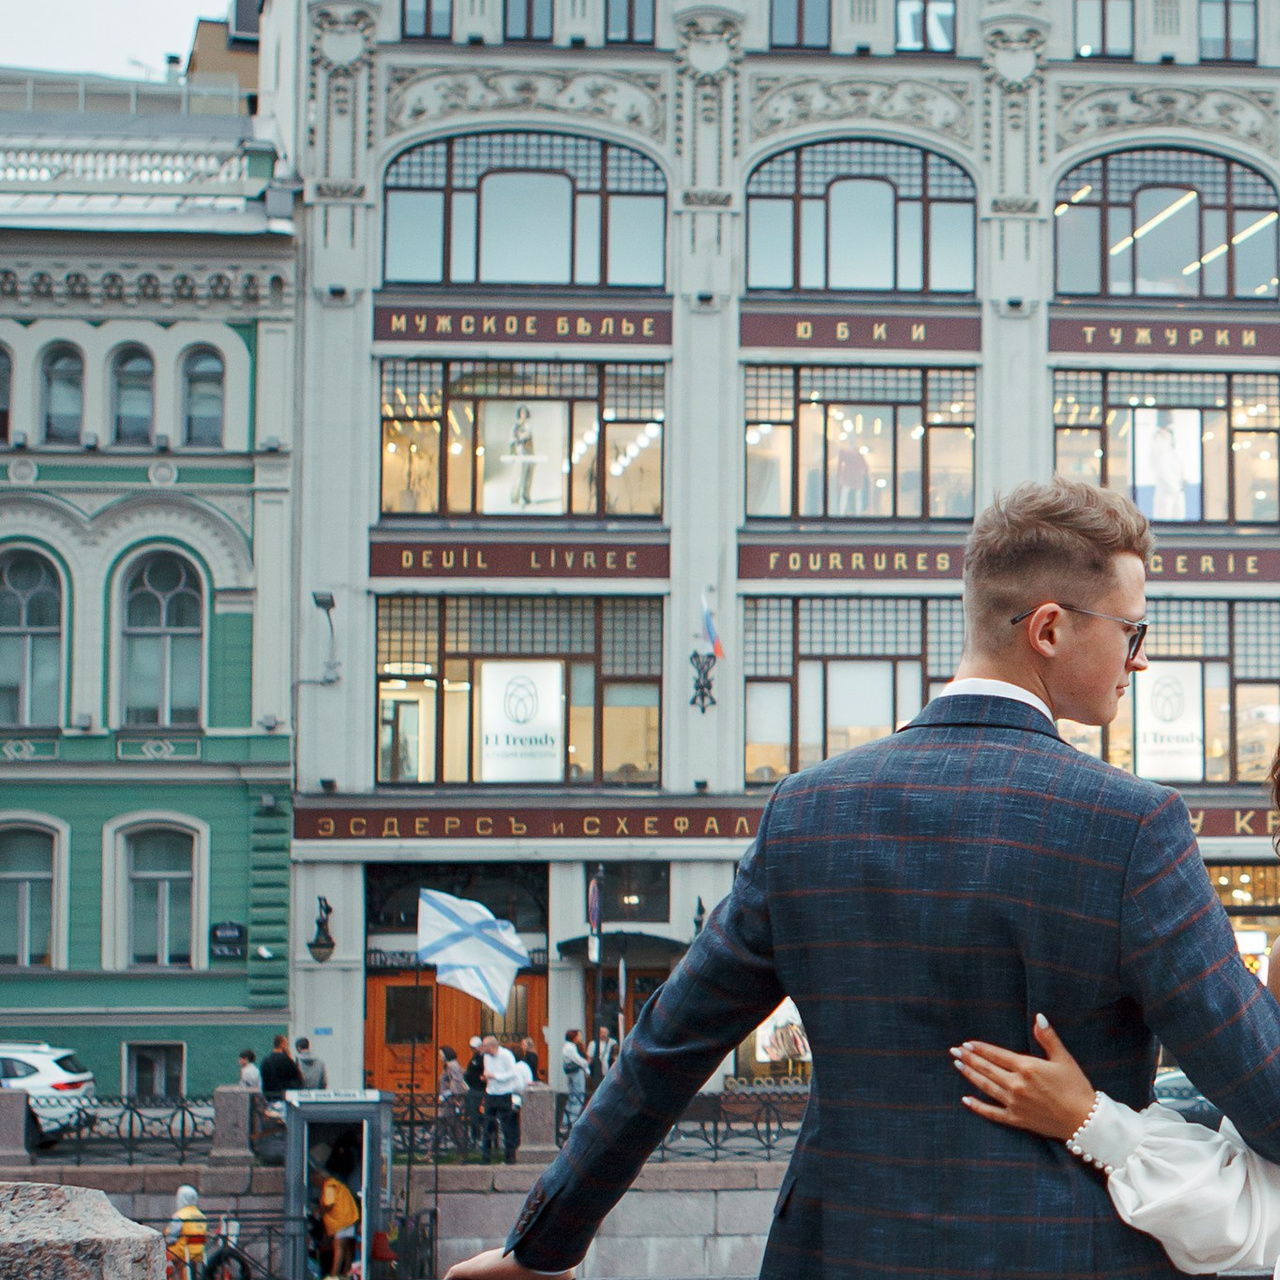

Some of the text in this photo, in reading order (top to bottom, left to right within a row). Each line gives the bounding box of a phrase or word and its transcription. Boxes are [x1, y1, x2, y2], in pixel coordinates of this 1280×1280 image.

[392, 315, 536, 335] МУЖСКОЕ
[797, 322, 925, 342] ЮБКИ
[1084, 327, 1256, 346] ТУЖУРКИ
[403, 549, 636, 569] DEUIL LIVREE
[770, 553, 949, 571] FOURRURES
[318, 816, 527, 835] ЭСДЕРСЪ
